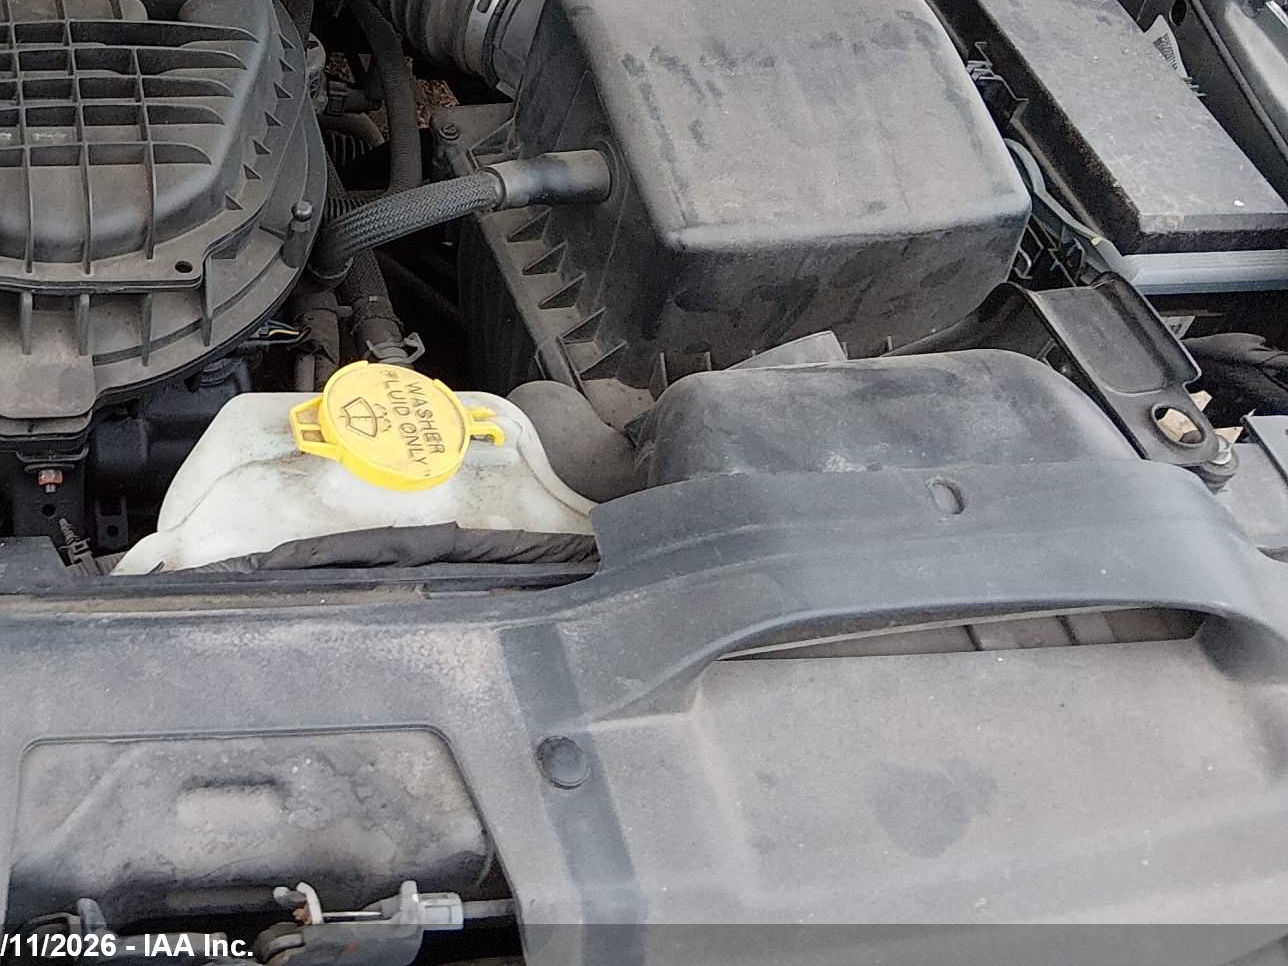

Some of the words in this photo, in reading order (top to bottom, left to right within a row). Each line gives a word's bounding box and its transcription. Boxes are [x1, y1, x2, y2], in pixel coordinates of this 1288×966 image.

[379, 369, 411, 417] FLUID
[400, 422, 429, 465] ONLY
[407, 381, 446, 454] WASHER
